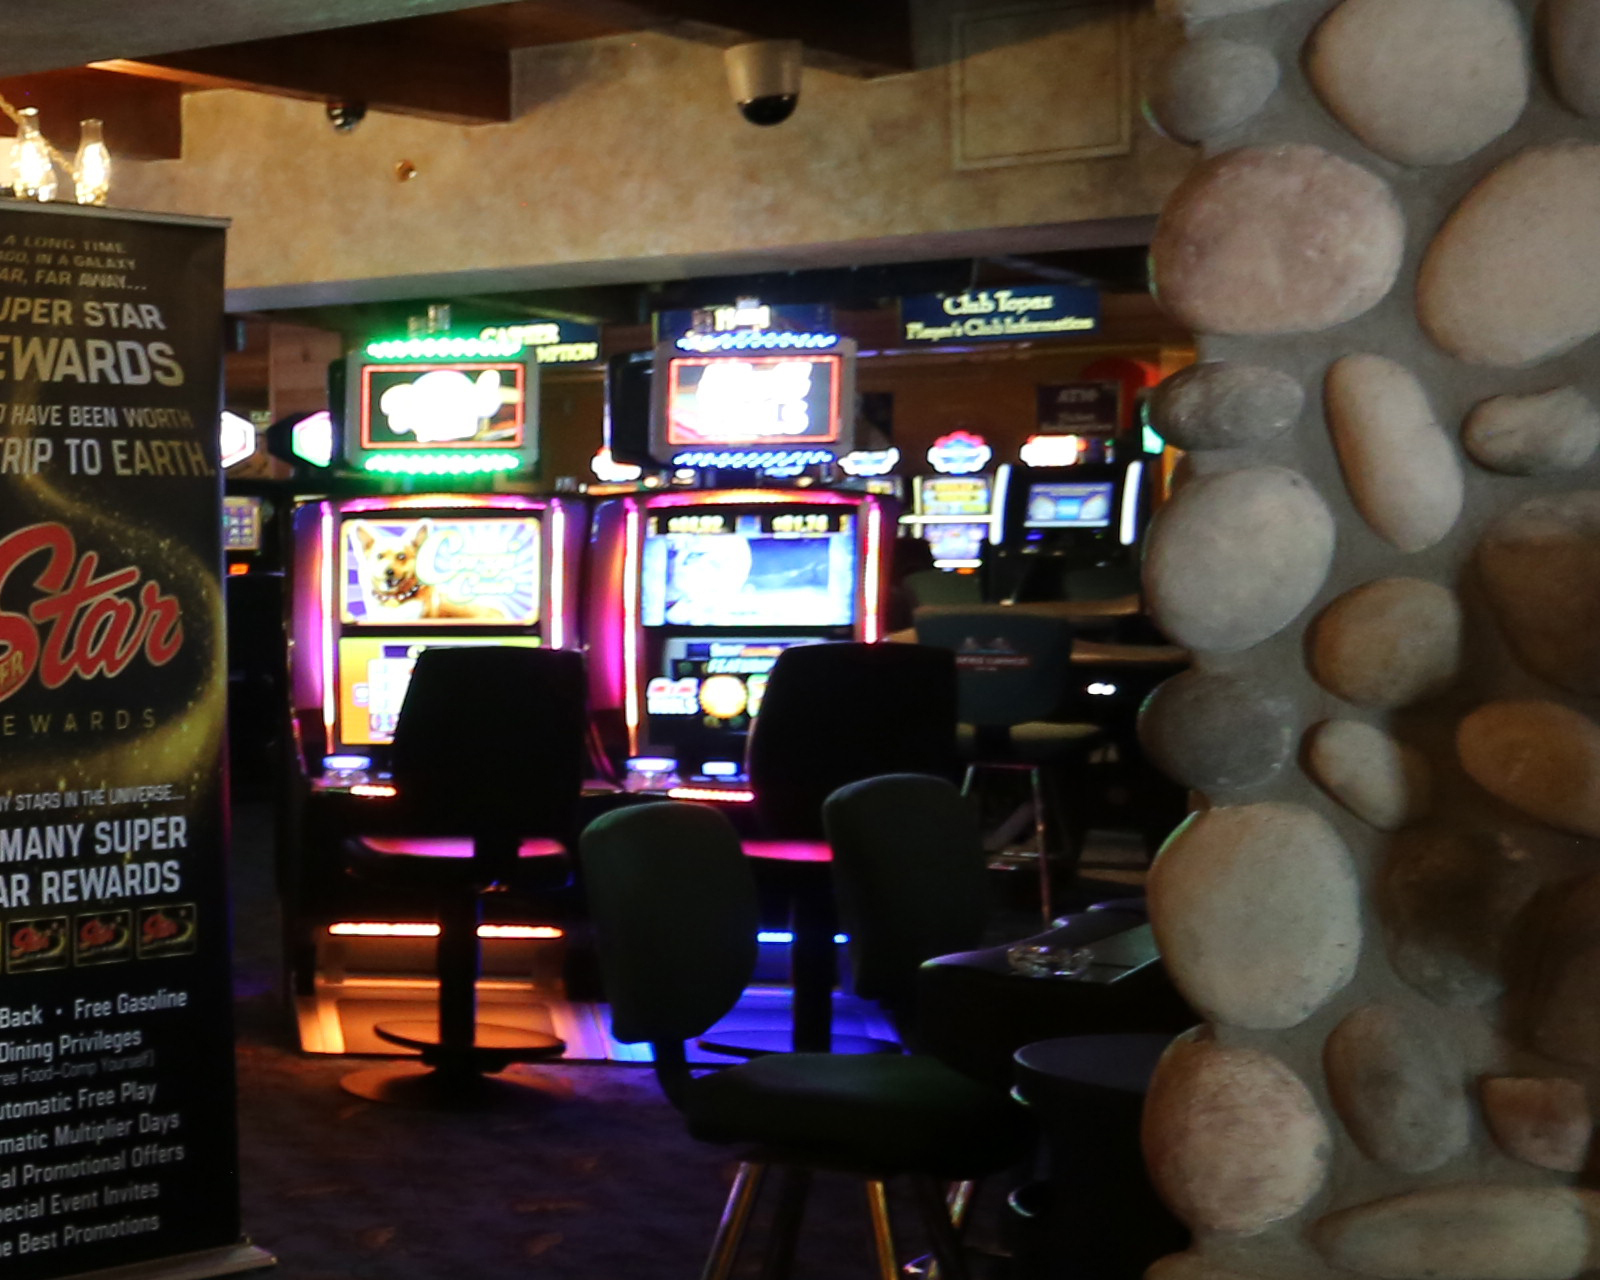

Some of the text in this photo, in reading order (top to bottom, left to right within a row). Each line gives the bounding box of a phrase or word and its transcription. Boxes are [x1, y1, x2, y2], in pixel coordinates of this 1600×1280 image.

[3, 234, 127, 253] A LONG TIME
[35, 253, 52, 265] IN
[57, 254, 69, 266] A
[73, 255, 136, 270] GALAXY
[35, 271, 73, 286] FAR
[943, 290, 1054, 315] Club Topaz
[83, 303, 167, 331] STAR
[964, 318, 1004, 336] Club
[536, 343, 597, 363] MPTION
[11, 404, 62, 427] HAVE
[69, 406, 119, 428] BEEN
[121, 407, 196, 430] WORTH
[65, 438, 101, 476] TO
[112, 439, 216, 477] EARTH.
[15, 791, 61, 812] STARS
[65, 790, 79, 808] IN
[82, 788, 105, 806] THE
[94, 815, 188, 855] SUPER
[41, 860, 181, 905] REWARDS
[74, 998, 112, 1019] Free
[116, 989, 188, 1014] Gasoline
[58, 1029, 143, 1056] Privileges
[78, 1087, 116, 1109] Free
[120, 1081, 158, 1105] Play
[54, 1117, 133, 1147] Multiplier
[139, 1111, 180, 1134] Days
[22, 1149, 127, 1186] Promotional
[131, 1143, 185, 1168] Offers
[50, 1190, 99, 1215] Event
[103, 1180, 160, 1207] Invites
[18, 1230, 58, 1254] Best
[62, 1213, 161, 1247] Promotions
